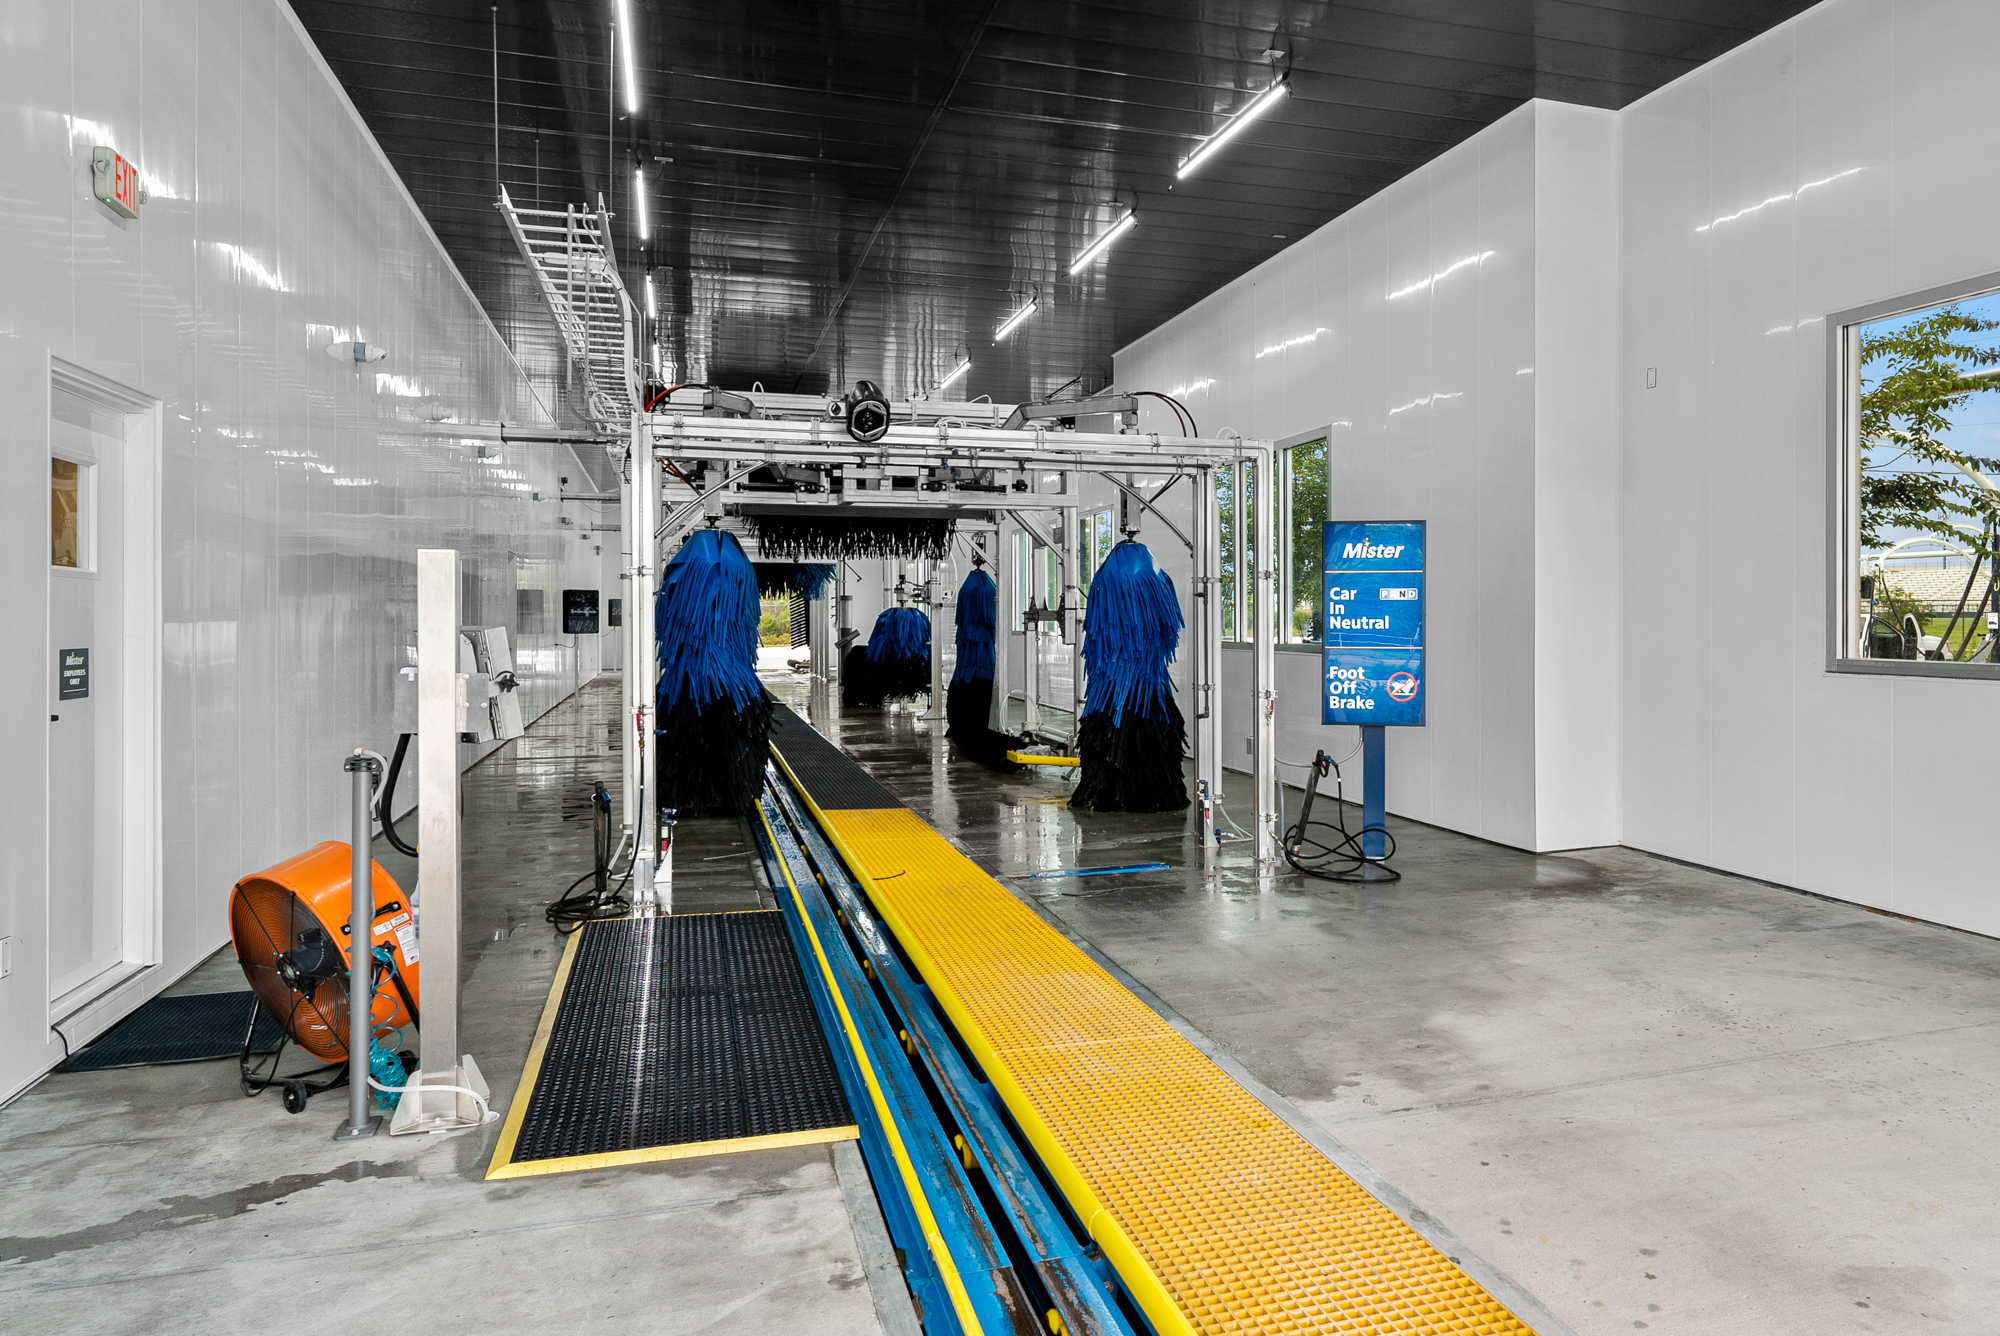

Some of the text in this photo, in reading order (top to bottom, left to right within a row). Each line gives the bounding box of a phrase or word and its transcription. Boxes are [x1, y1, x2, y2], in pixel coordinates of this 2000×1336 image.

[115, 153, 136, 211] EXIT
[1342, 542, 1405, 559] Mister
[1329, 586, 1357, 601] Car
[1329, 602, 1345, 615] In
[1329, 615, 1390, 630] Neutral
[65, 654, 84, 665] Mister
[1329, 666, 1365, 680] Foot
[1329, 680, 1357, 695] Off
[1329, 695, 1375, 710] Brake
